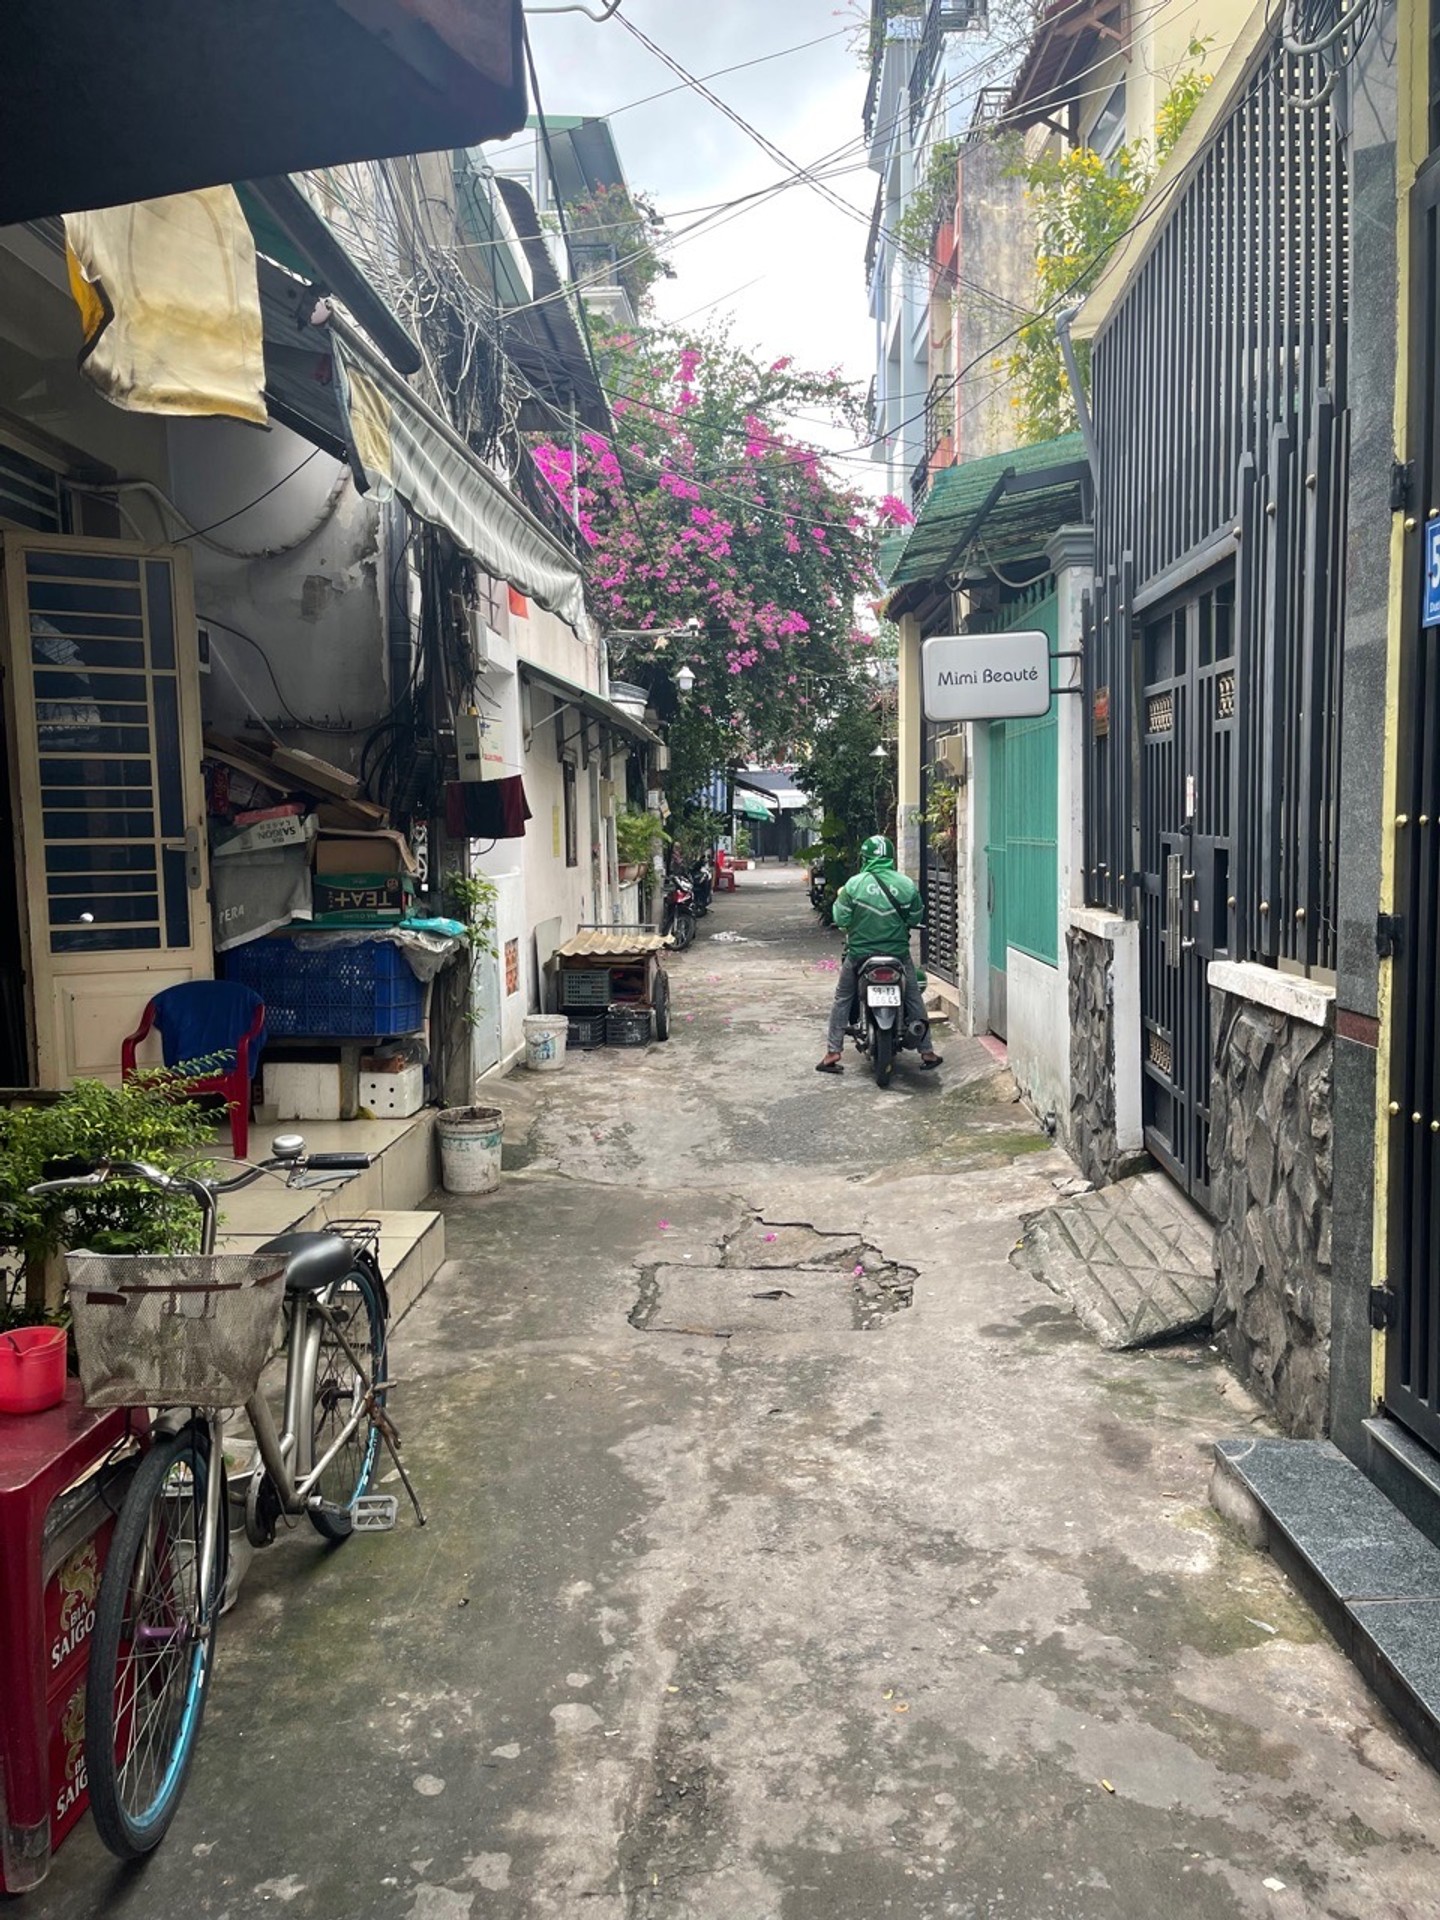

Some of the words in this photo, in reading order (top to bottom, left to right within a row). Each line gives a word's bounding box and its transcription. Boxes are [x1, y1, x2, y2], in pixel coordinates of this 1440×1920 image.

[938, 670, 978, 686] Mimi
[982, 666, 1039, 684] Beauté
[258, 827, 296, 840] SAIGON
[334, 890, 392, 908] TEA+
[866, 884, 899, 897] Grb
[70, 1602, 87, 1627] BIA
[52, 1609, 96, 1670] SAIGO
[74, 1754, 85, 1775] BI
[57, 1766, 89, 1820] SAIG
